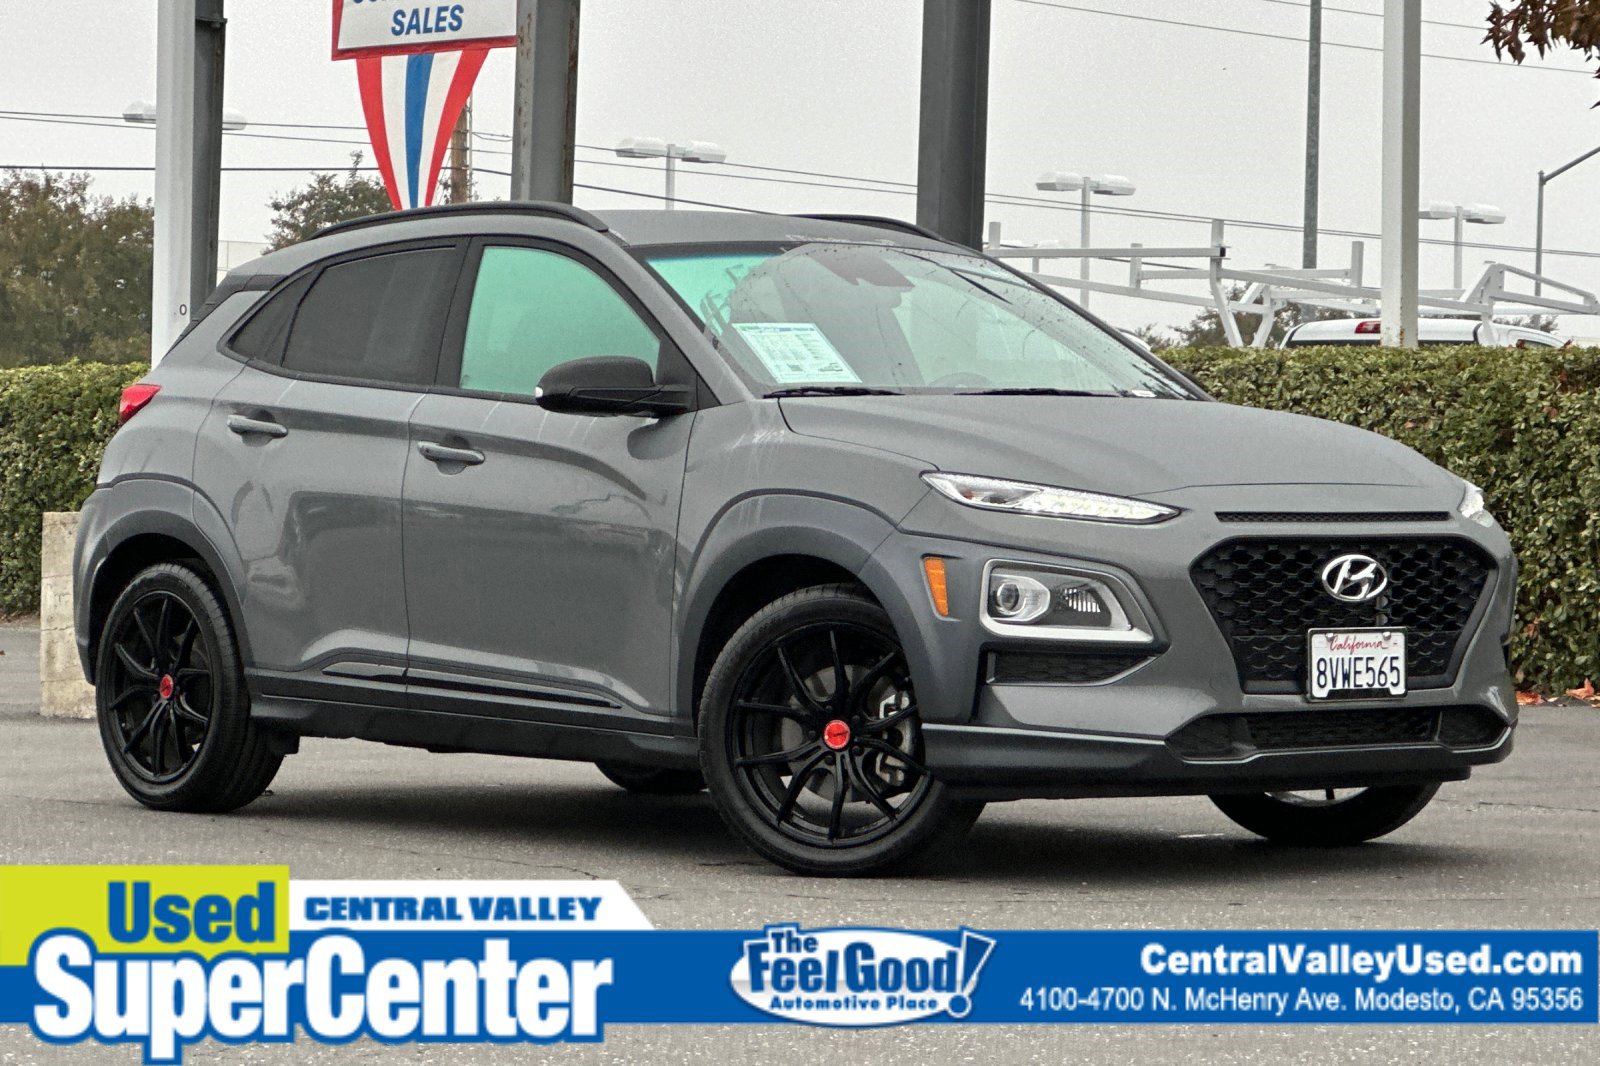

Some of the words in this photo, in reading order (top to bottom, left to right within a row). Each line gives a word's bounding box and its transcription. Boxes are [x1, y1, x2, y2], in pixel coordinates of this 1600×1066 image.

[392, 4, 463, 36] SALES
[1330, 635, 1388, 655] California
[1317, 656, 1400, 688] 8VWE565
